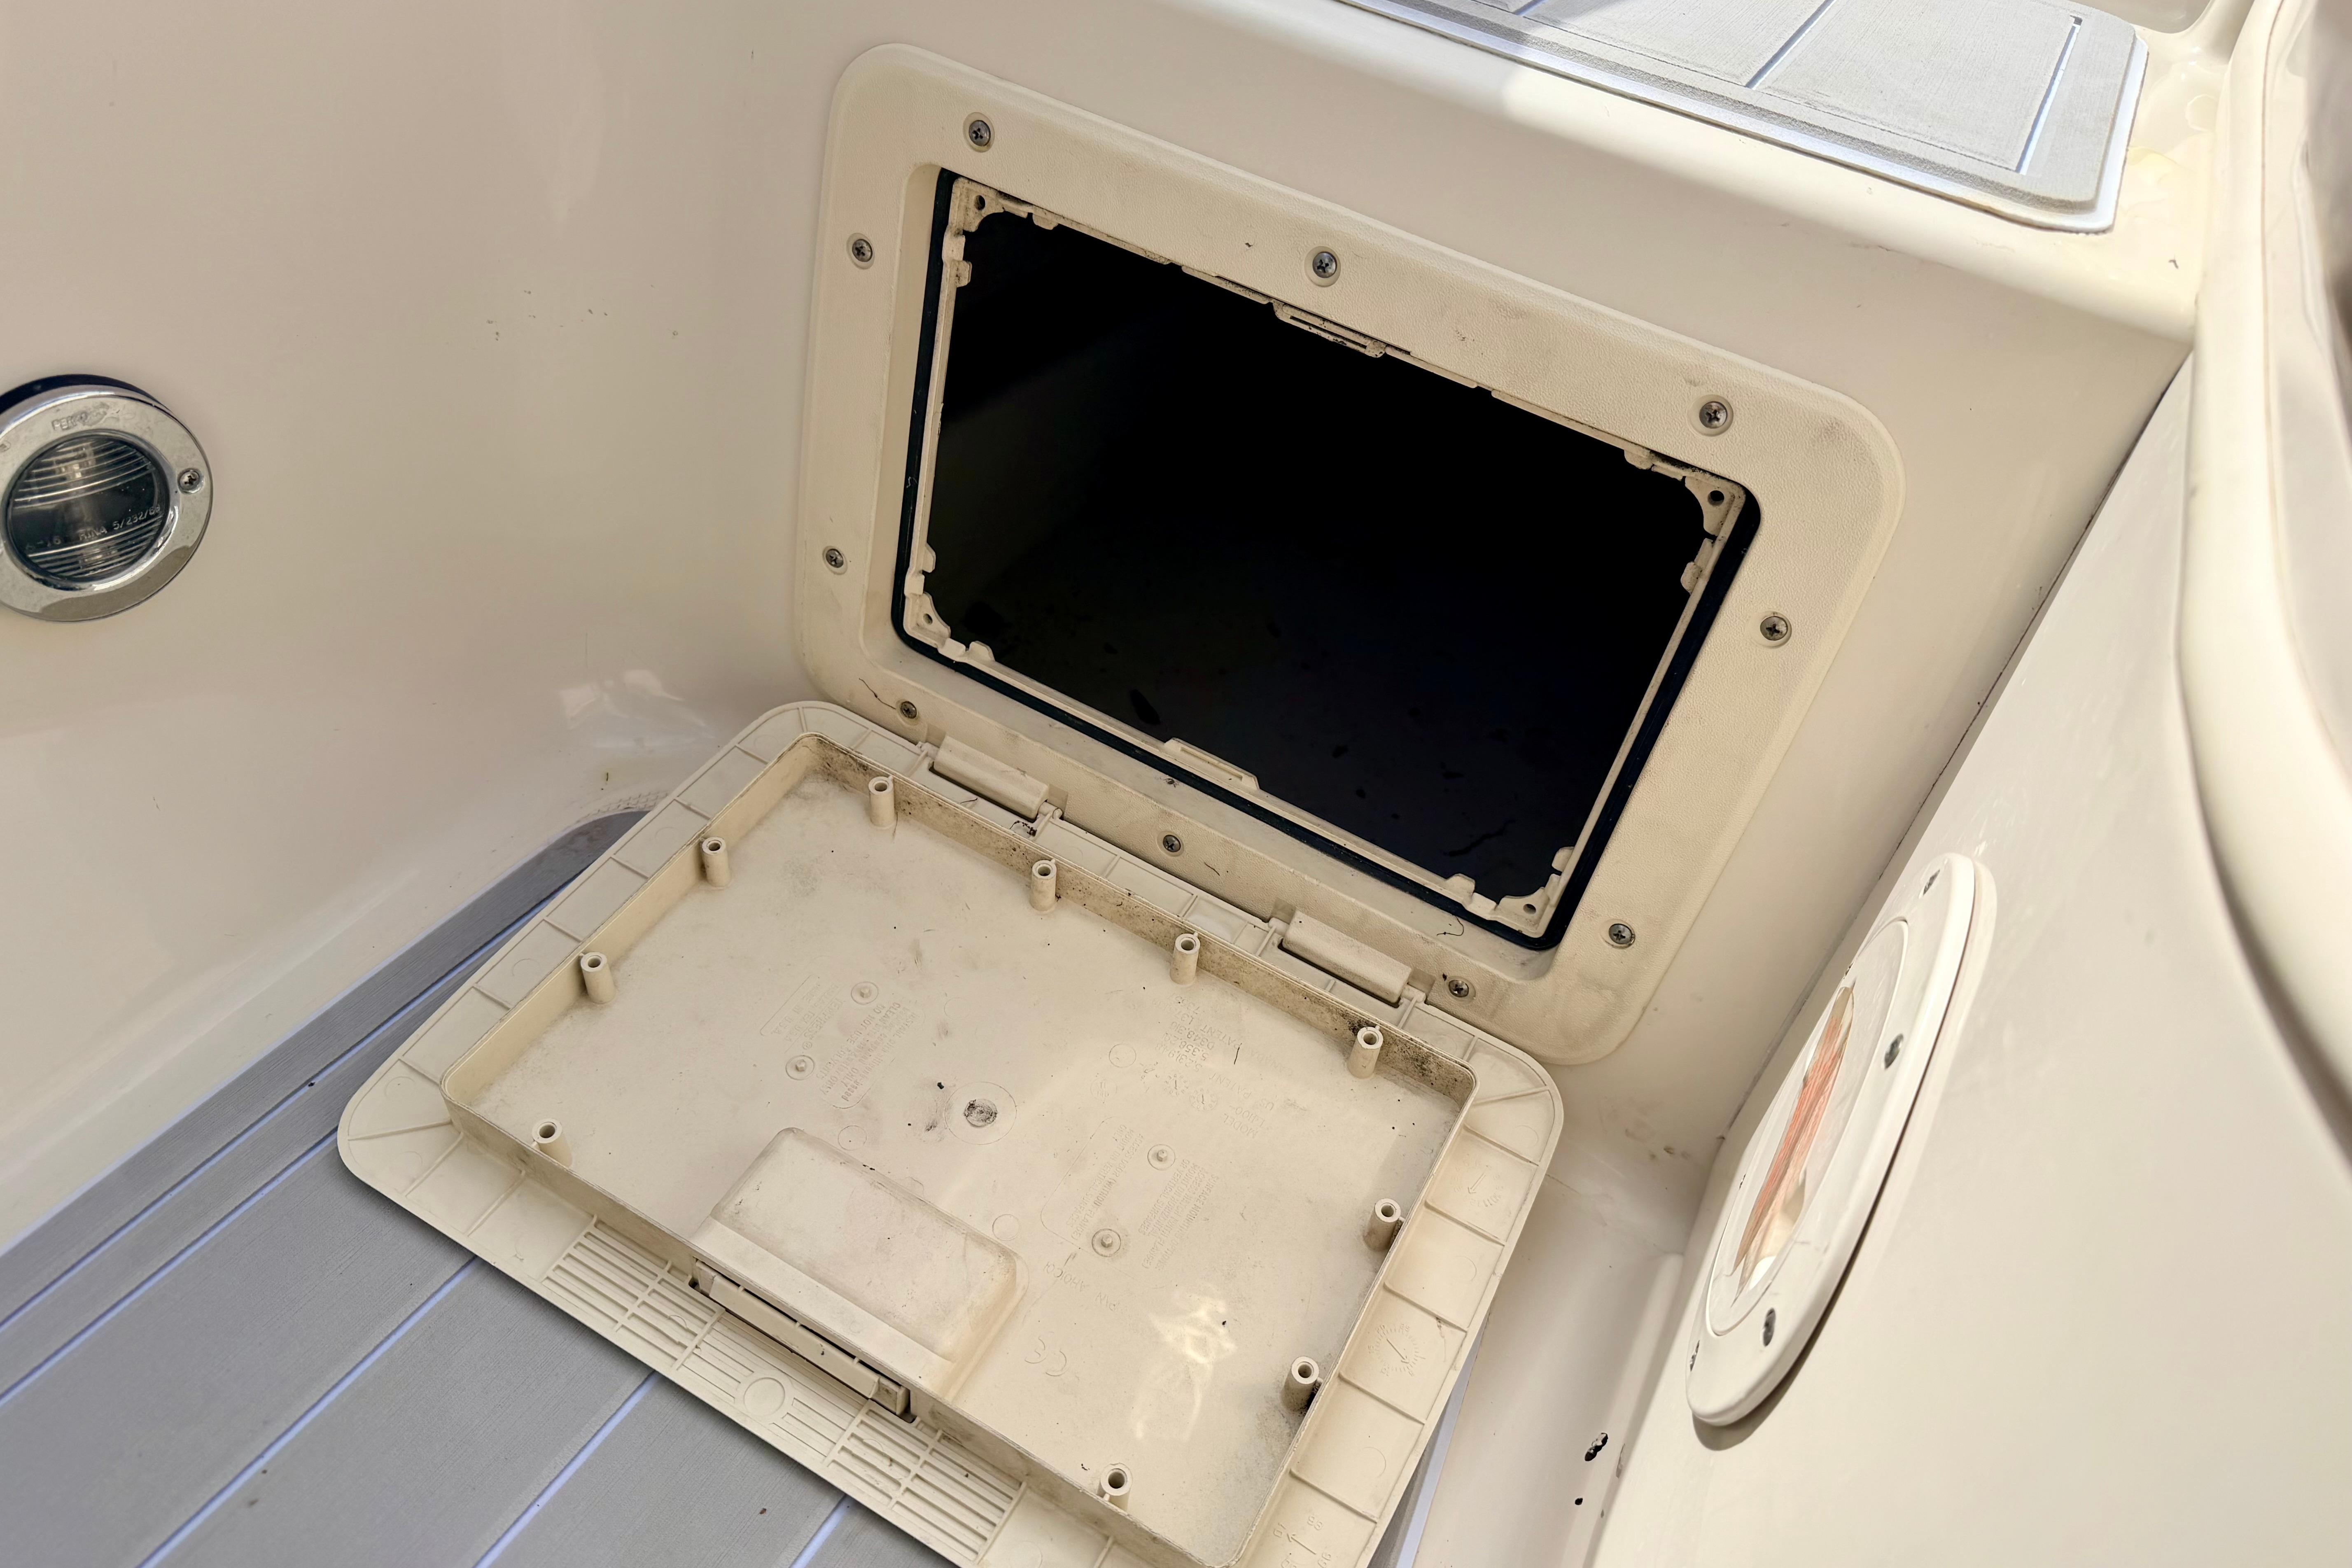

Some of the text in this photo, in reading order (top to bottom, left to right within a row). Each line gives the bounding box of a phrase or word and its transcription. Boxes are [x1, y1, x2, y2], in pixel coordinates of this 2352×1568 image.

[79, 526, 107, 541] RINA
[873, 1003, 884, 1014] DO
[879, 1001, 901, 1025] CLEAN
[861, 1014, 875, 1029] NOT
[847, 1029, 861, 1045] USE
[840, 1066, 859, 1087] ONLY
[1210, 1072, 1250, 1098] PATENT
[1222, 1115, 1257, 1137] MODEL
[1125, 1134, 1145, 1160] ACCESS
[1066, 1129, 1135, 1227] MOUNT ON VERTICAL SURFACES
[1113, 1159, 1128, 1178] DOOR
[1188, 1167, 1208, 1194] ACCESS
[1138, 1158, 1190, 1235] OR VERTICAL SURFACES
[1148, 1163, 1199, 1239] MOUNT ON HORIZONTAL
[1196, 1174, 1218, 1205] SURFACE
[1175, 1204, 1200, 1240] MOUNTING
